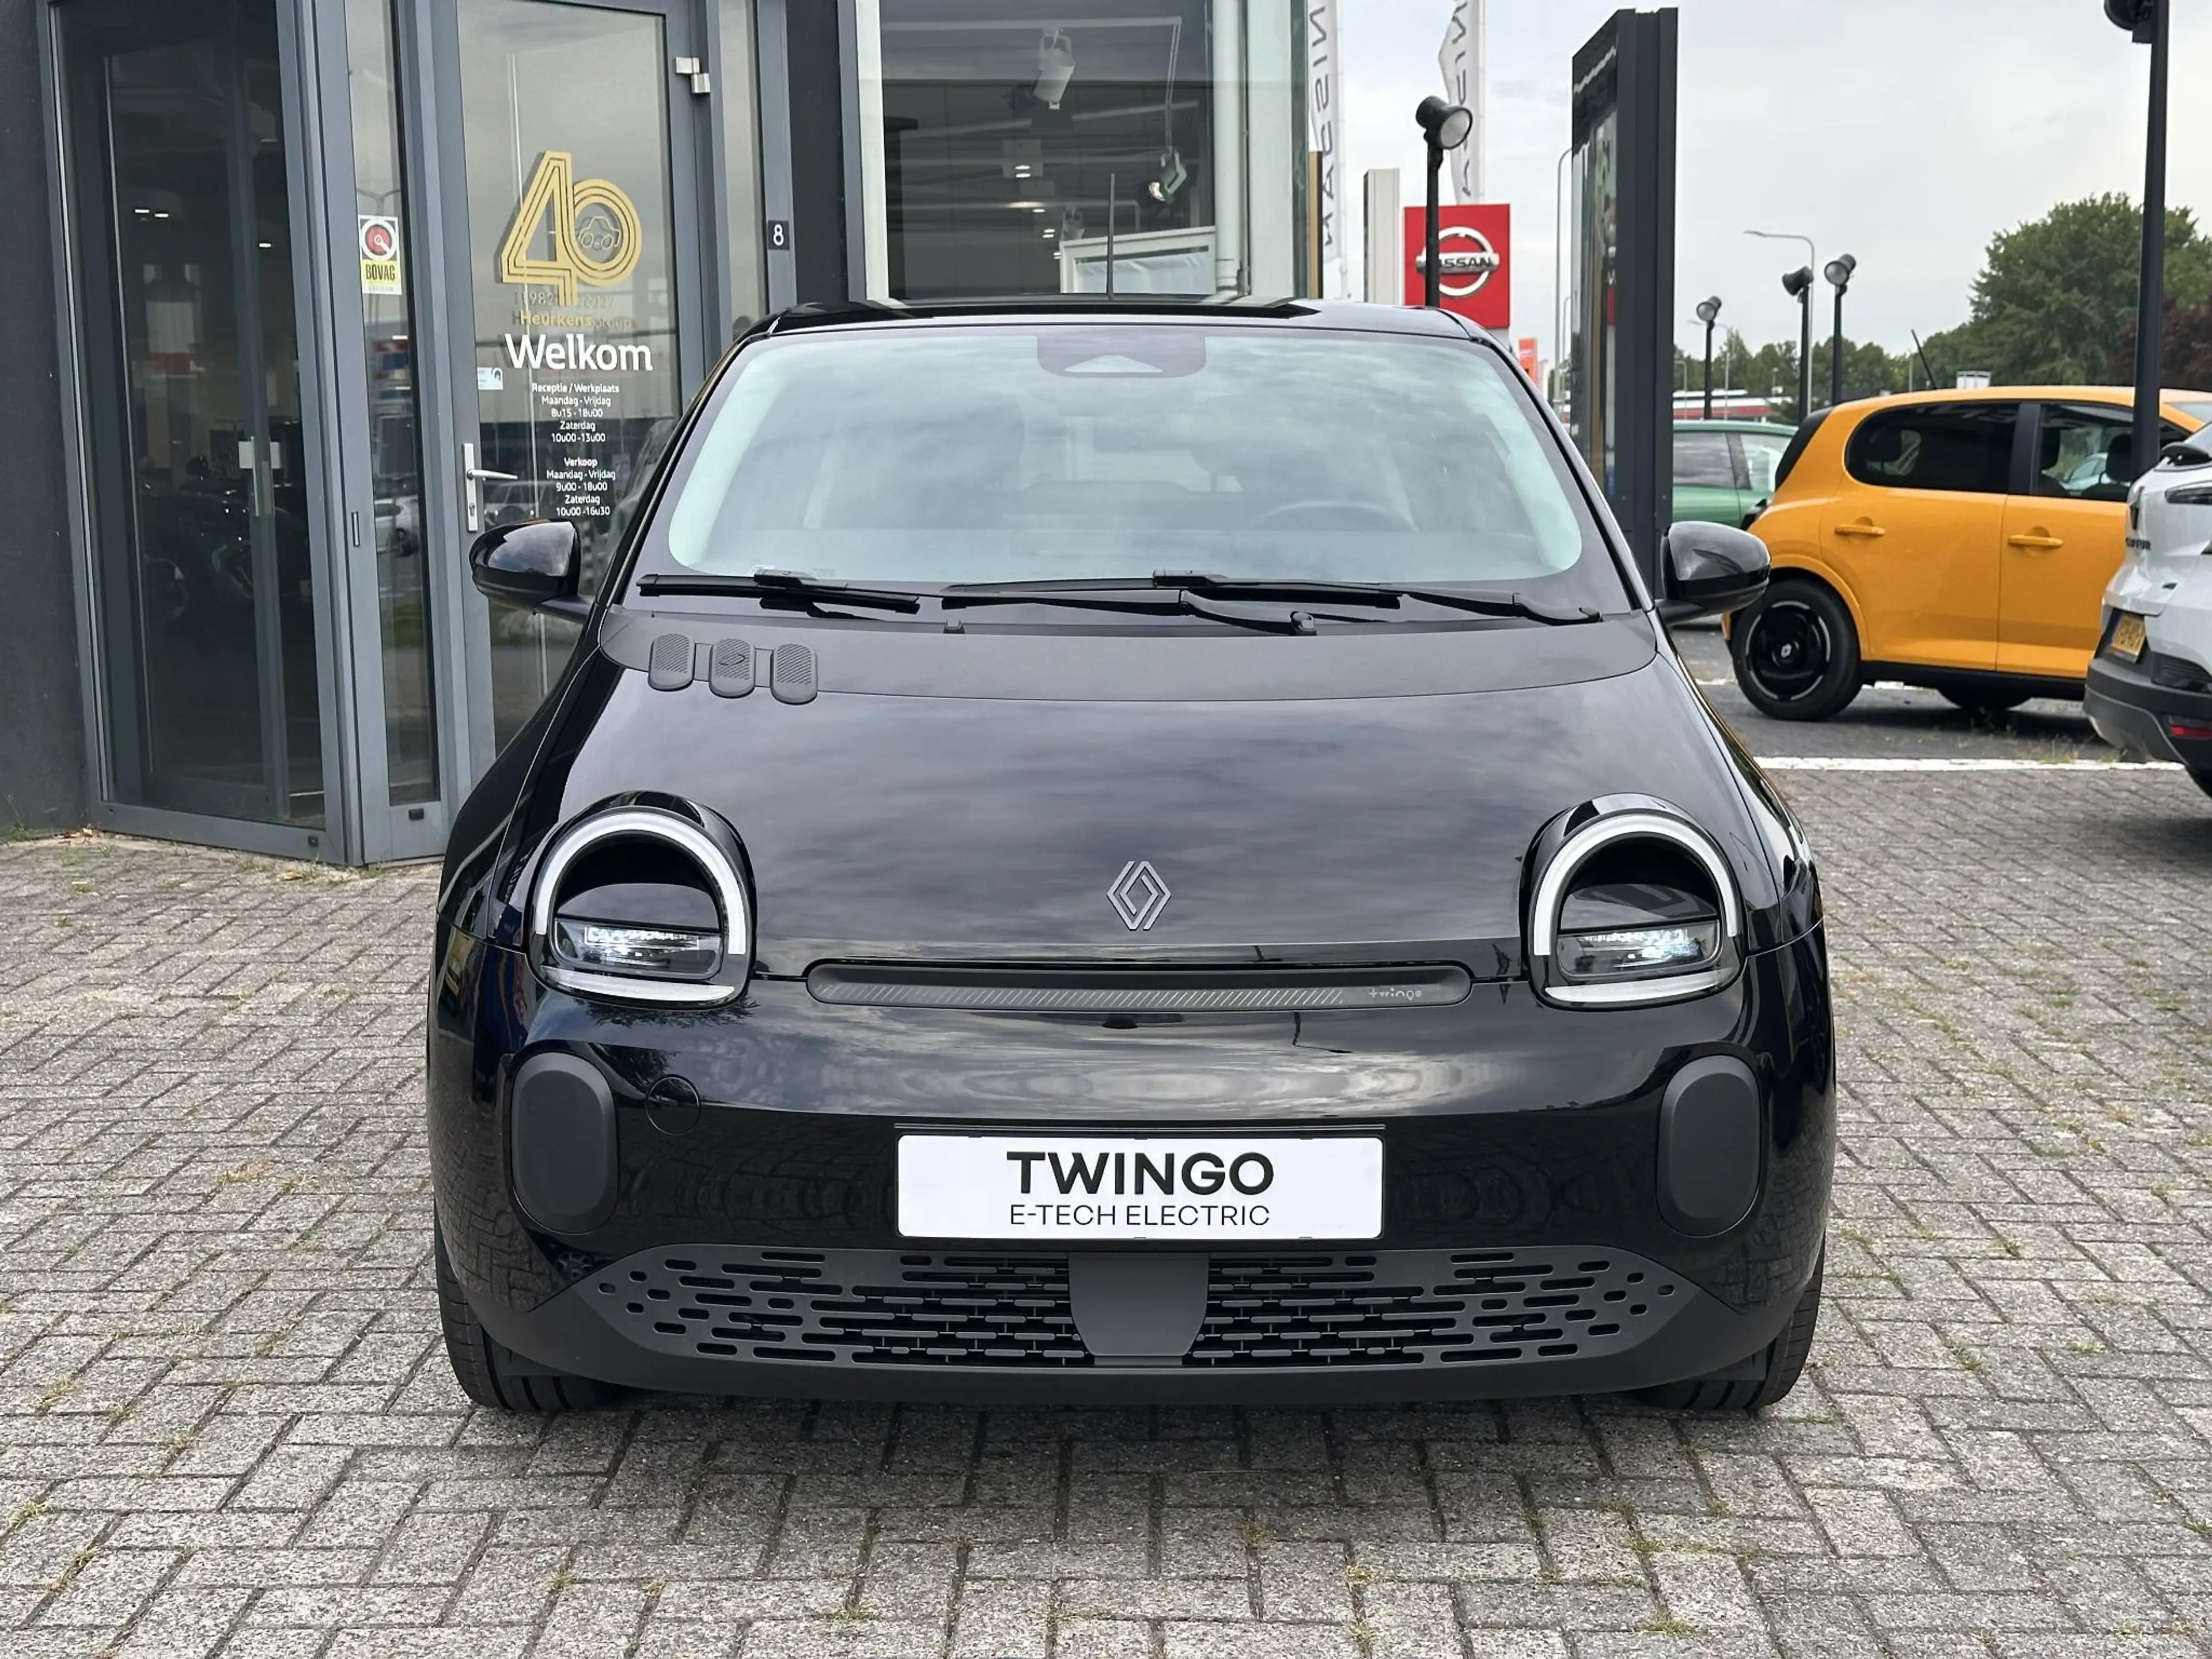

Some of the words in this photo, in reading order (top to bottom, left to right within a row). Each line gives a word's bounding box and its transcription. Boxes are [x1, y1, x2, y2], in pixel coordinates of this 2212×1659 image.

[773, 224, 784, 246] 8
[365, 263, 396, 281] BOVAG
[505, 334, 653, 370] Welkom
[541, 396, 578, 407] Maandag
[584, 396, 611, 407] Vrijdag
[560, 421, 596, 431] Zaterdag
[551, 433, 576, 442] 10u00
[581, 433, 605, 442] 13u00
[564, 457, 598, 468] Verkoop
[547, 470, 583, 480] Maandag
[588, 470, 616, 480] Vrijdag
[556, 482, 576, 491] 9u00
[584, 482, 608, 491] 18u00
[565, 495, 600, 505] Zaterdag
[556, 507, 581, 516] 10u00
[586, 507, 610, 516] 16u30
[1007, 1152, 1274, 1195] TWINGO
[1010, 1205, 1116, 1225] E-TECH
[1126, 1205, 1270, 1226] ELECTRIC
